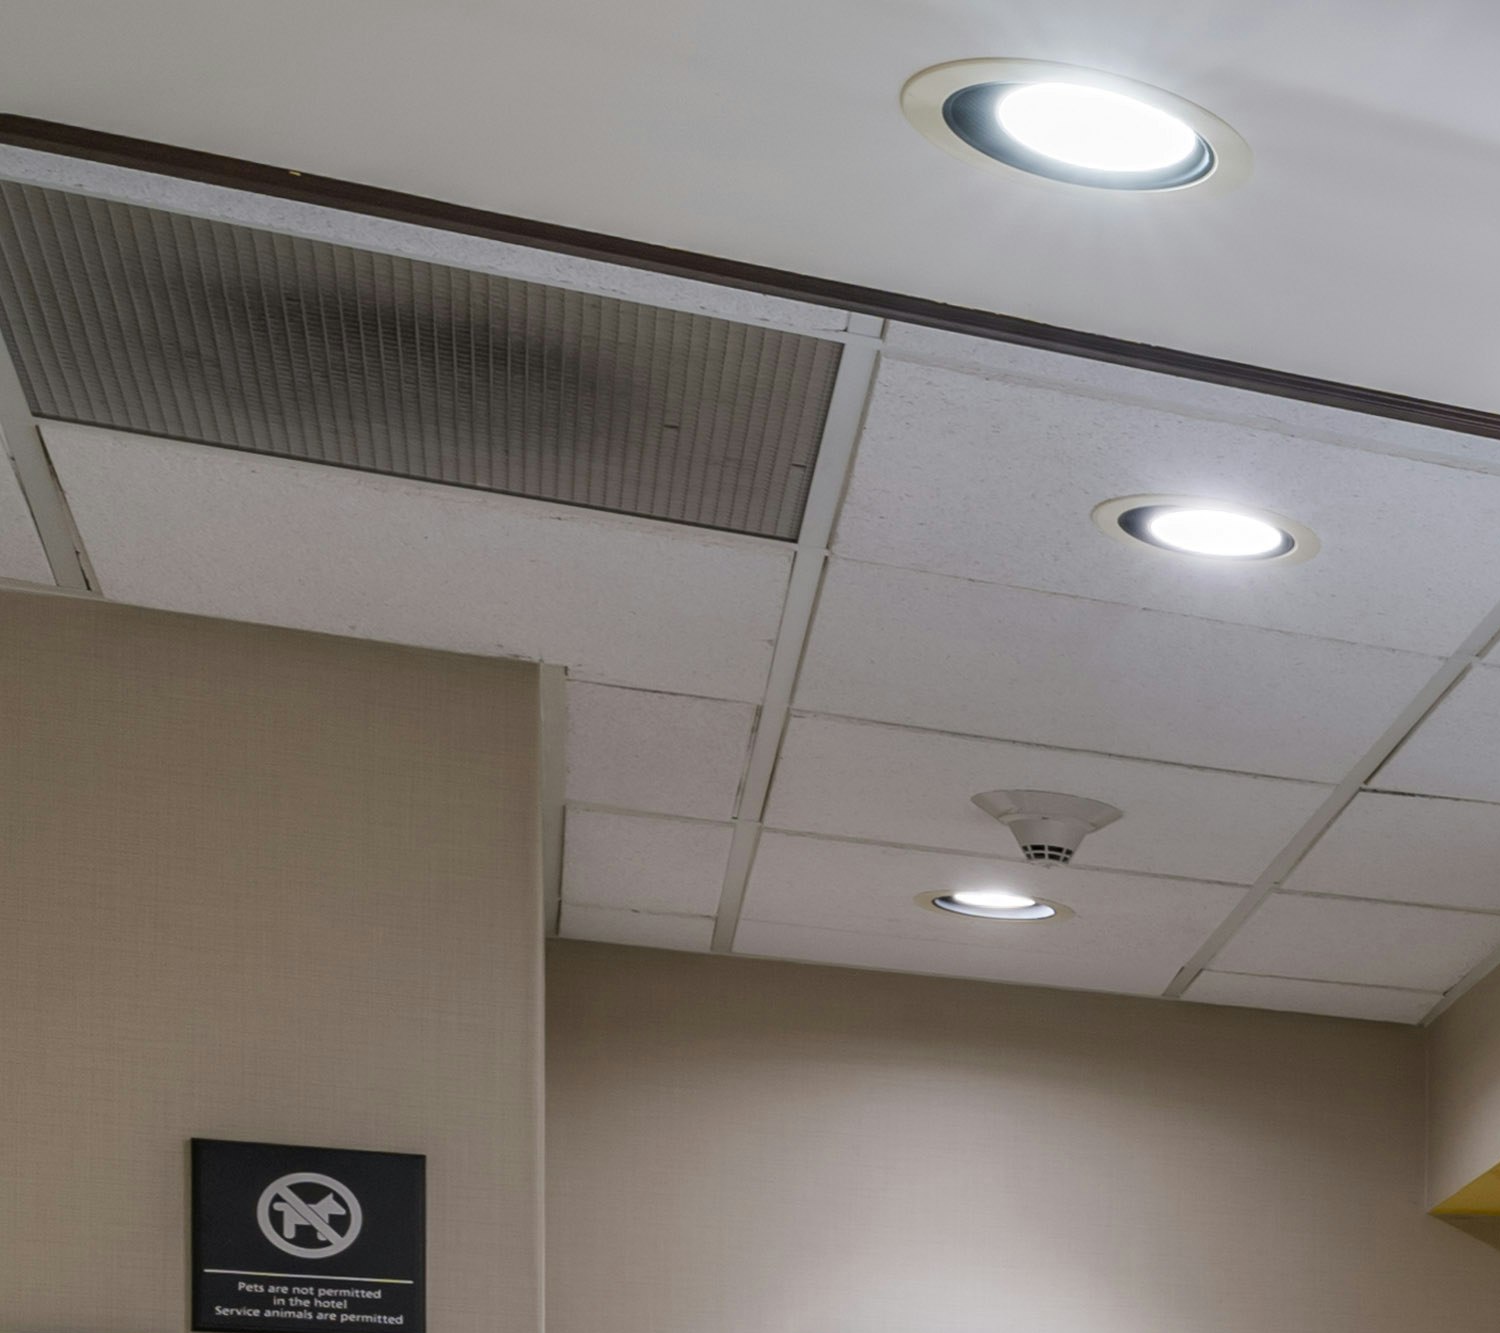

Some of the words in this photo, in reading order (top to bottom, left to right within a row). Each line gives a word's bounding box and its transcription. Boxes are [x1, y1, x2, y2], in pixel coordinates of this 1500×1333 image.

[238, 1281, 264, 1293] Pets
[268, 1285, 288, 1295] are
[292, 1285, 314, 1296] not
[318, 1286, 382, 1300] permitted
[273, 1296, 285, 1306] in
[289, 1296, 310, 1307] the
[314, 1298, 348, 1309] hotel
[215, 1305, 260, 1317] Service
[264, 1308, 313, 1320] animals
[316, 1312, 337, 1321] are
[340, 1312, 404, 1325] permitted
